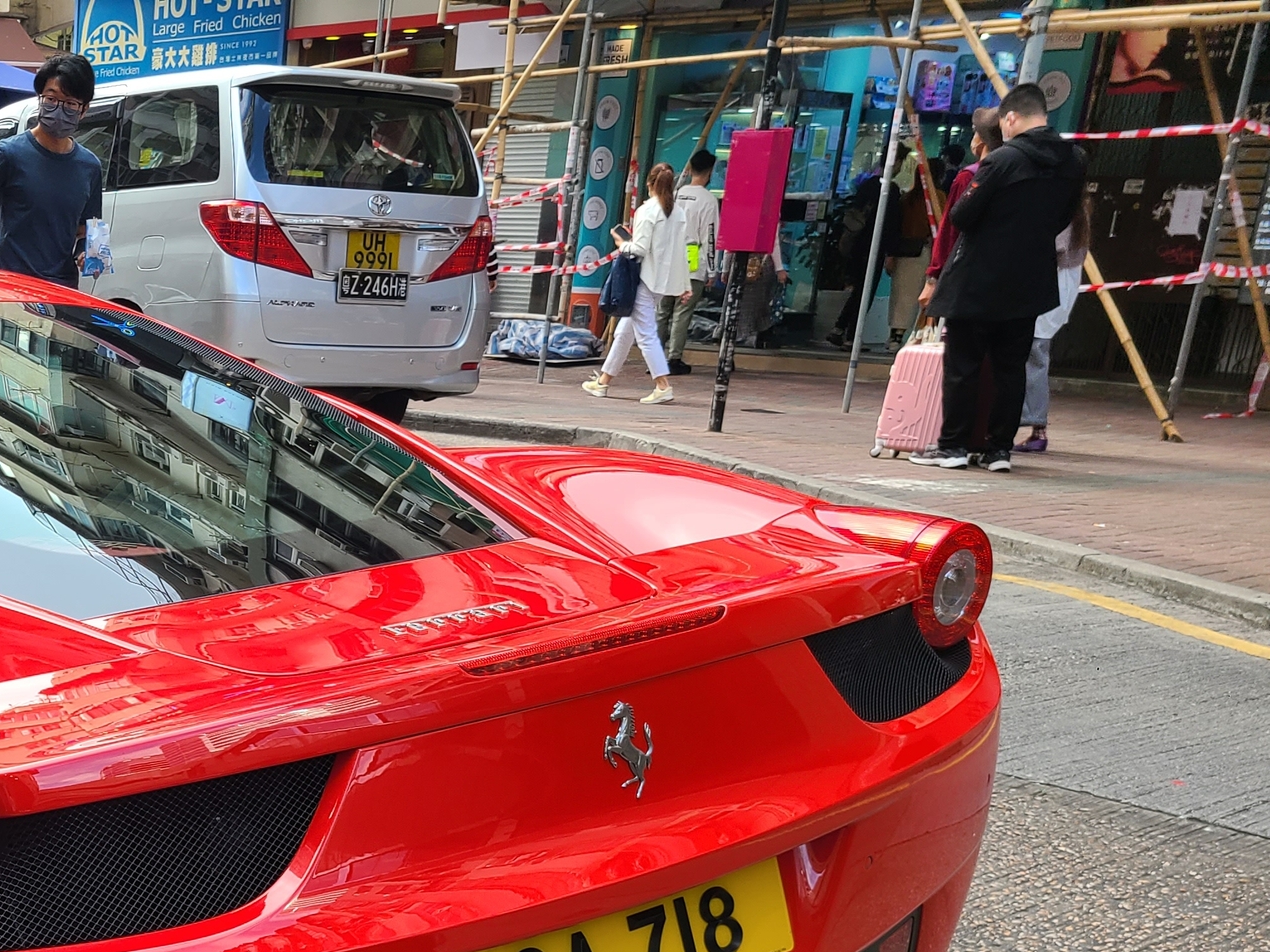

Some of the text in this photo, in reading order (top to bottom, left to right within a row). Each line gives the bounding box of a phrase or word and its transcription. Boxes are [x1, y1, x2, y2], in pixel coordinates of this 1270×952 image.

[90, 24, 134, 45] HOT
[152, 12, 281, 37] Large Fried Chicken
[83, 43, 140, 63] STAR
[220, 41, 240, 50] SINCE
[607, 44, 625, 53] MADE
[151, 42, 218, 71] 豪大大雞排
[100, 67, 115, 77] Fried
[116, 66, 139, 77] Chicken
[362, 232, 386, 252] UH
[354, 250, 393, 270] 9991
